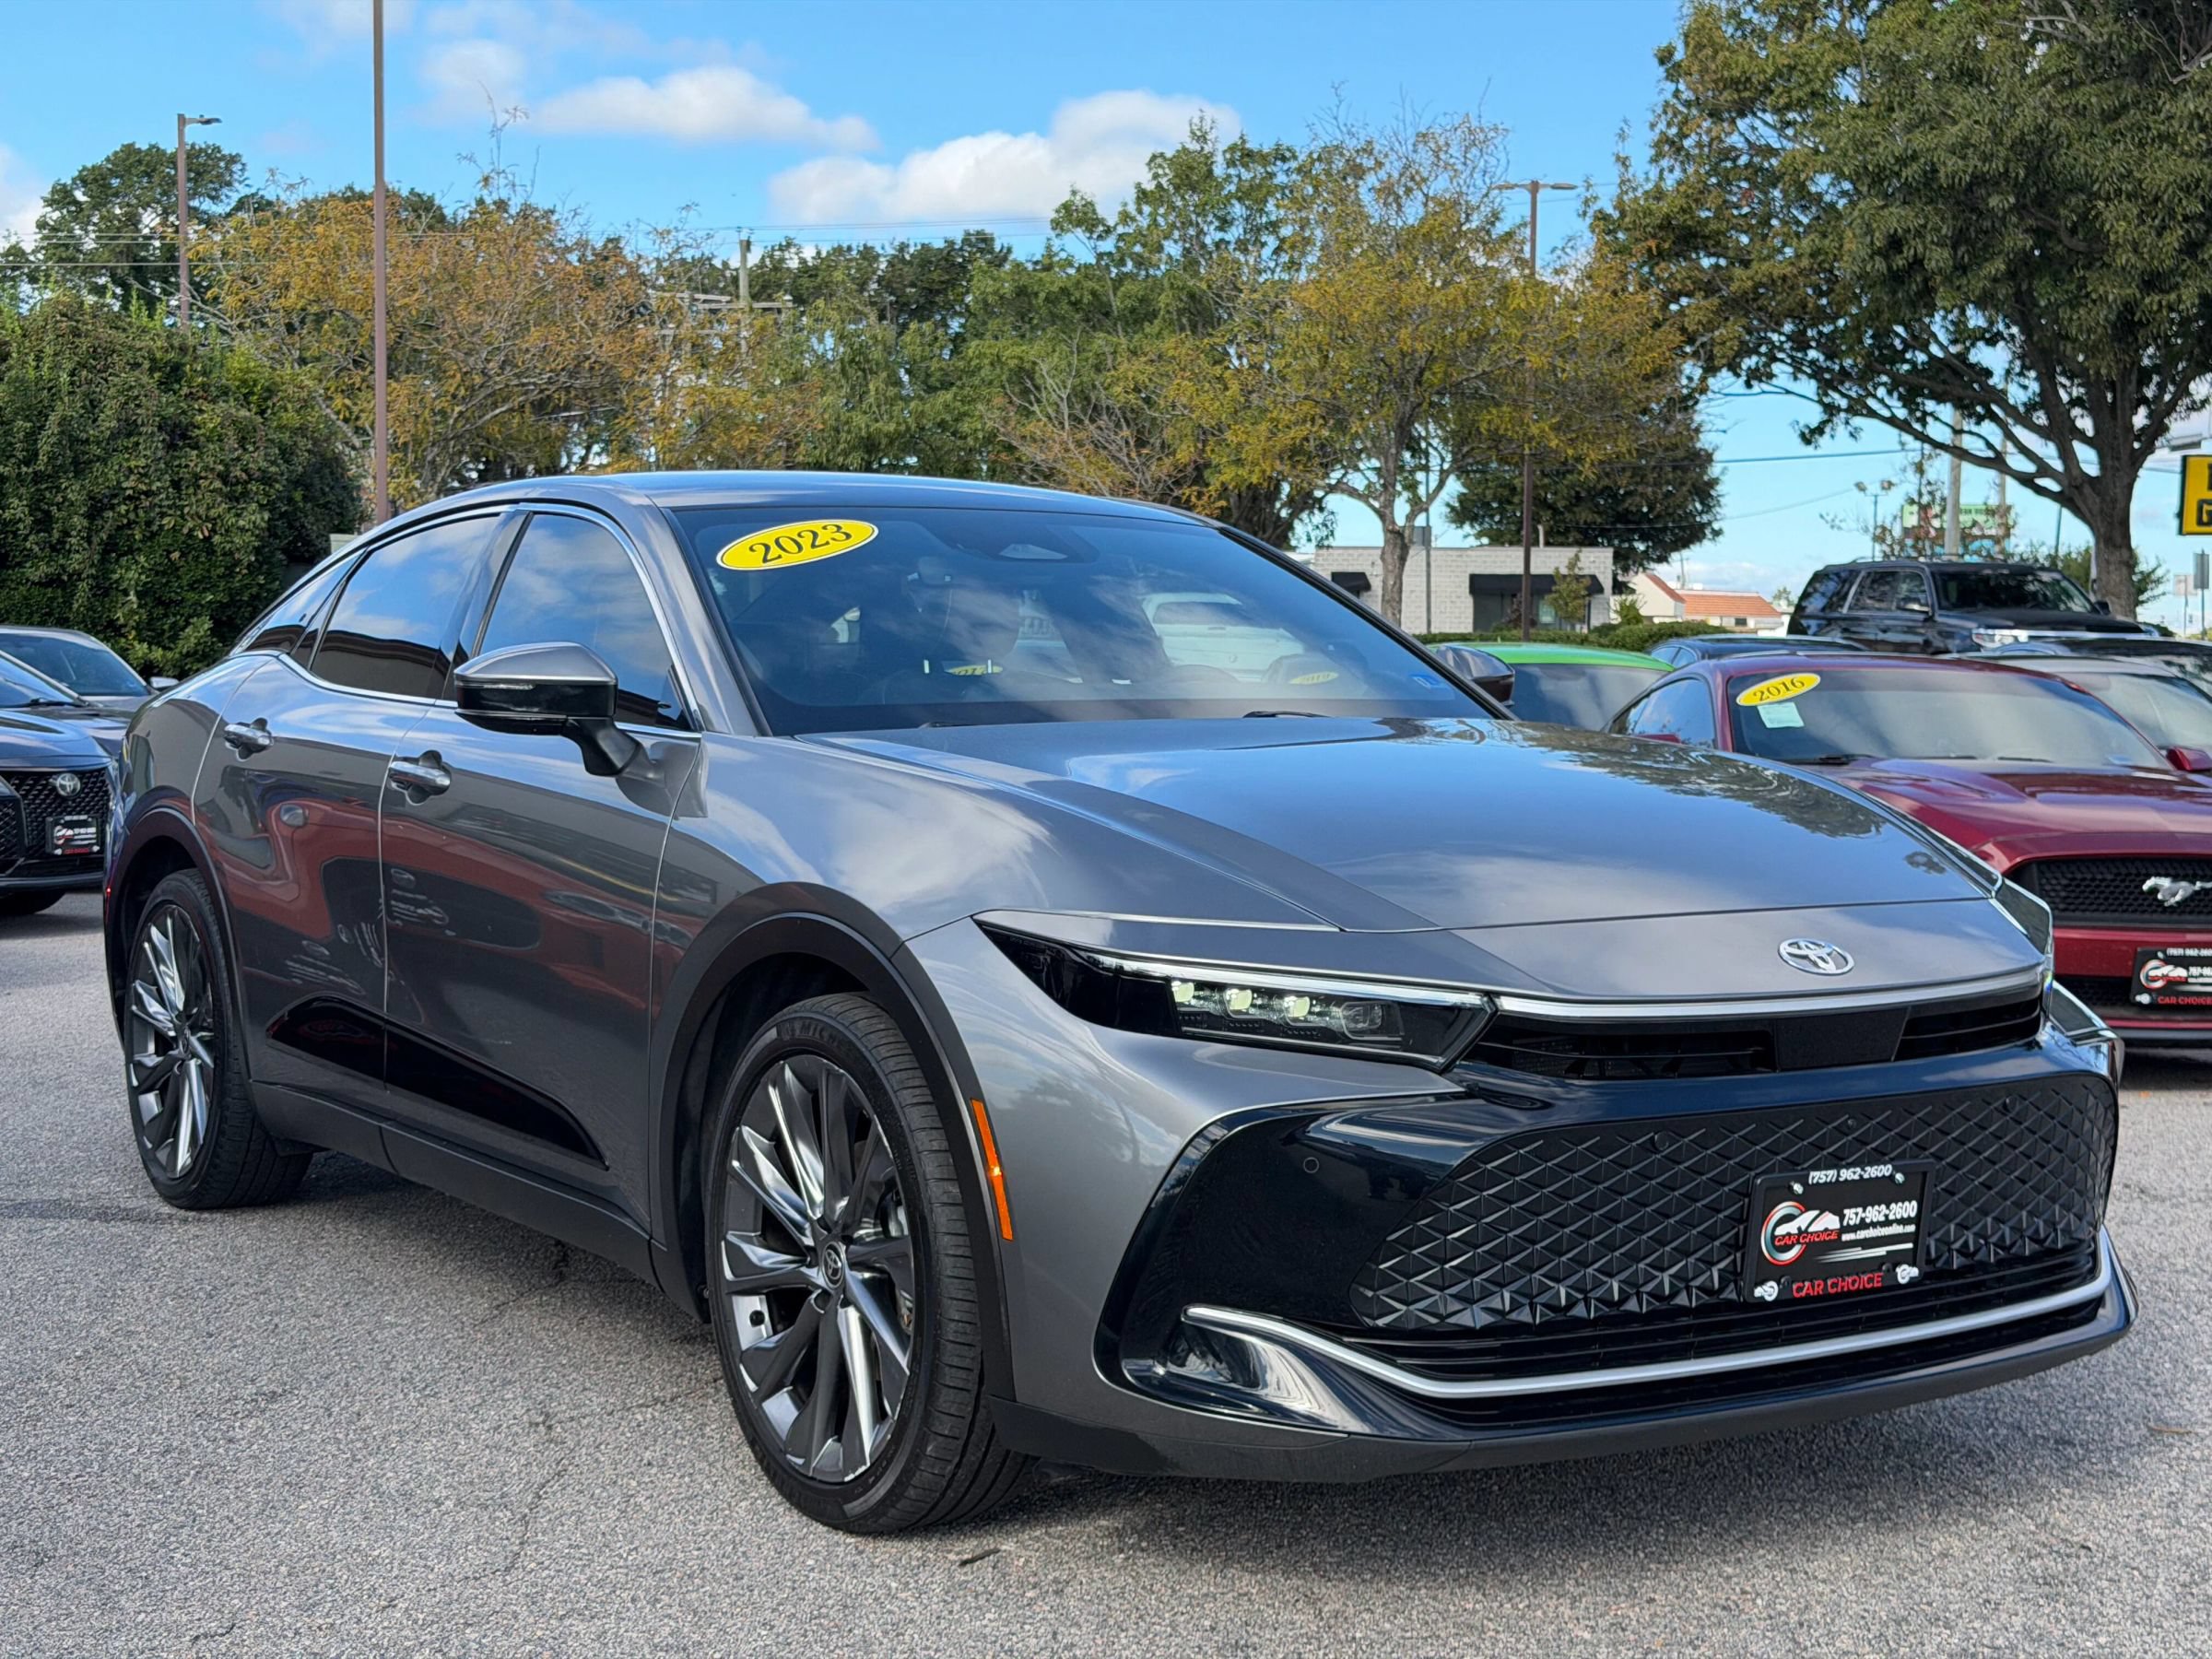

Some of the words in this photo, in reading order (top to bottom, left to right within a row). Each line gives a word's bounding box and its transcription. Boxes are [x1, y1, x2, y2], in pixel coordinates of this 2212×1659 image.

[748, 524, 853, 564] 2023
[1753, 677, 1806, 701] 2016
[1808, 1169, 1838, 1185] (757)
[1839, 1163, 1893, 1182] 962-2600
[1843, 1200, 1917, 1226] 757-962-2600
[1774, 1235, 1798, 1246] CAR
[1799, 1230, 1840, 1243] CHOICE
[1793, 1278, 1825, 1298] CAR
[1827, 1272, 1884, 1294] CHOICE
